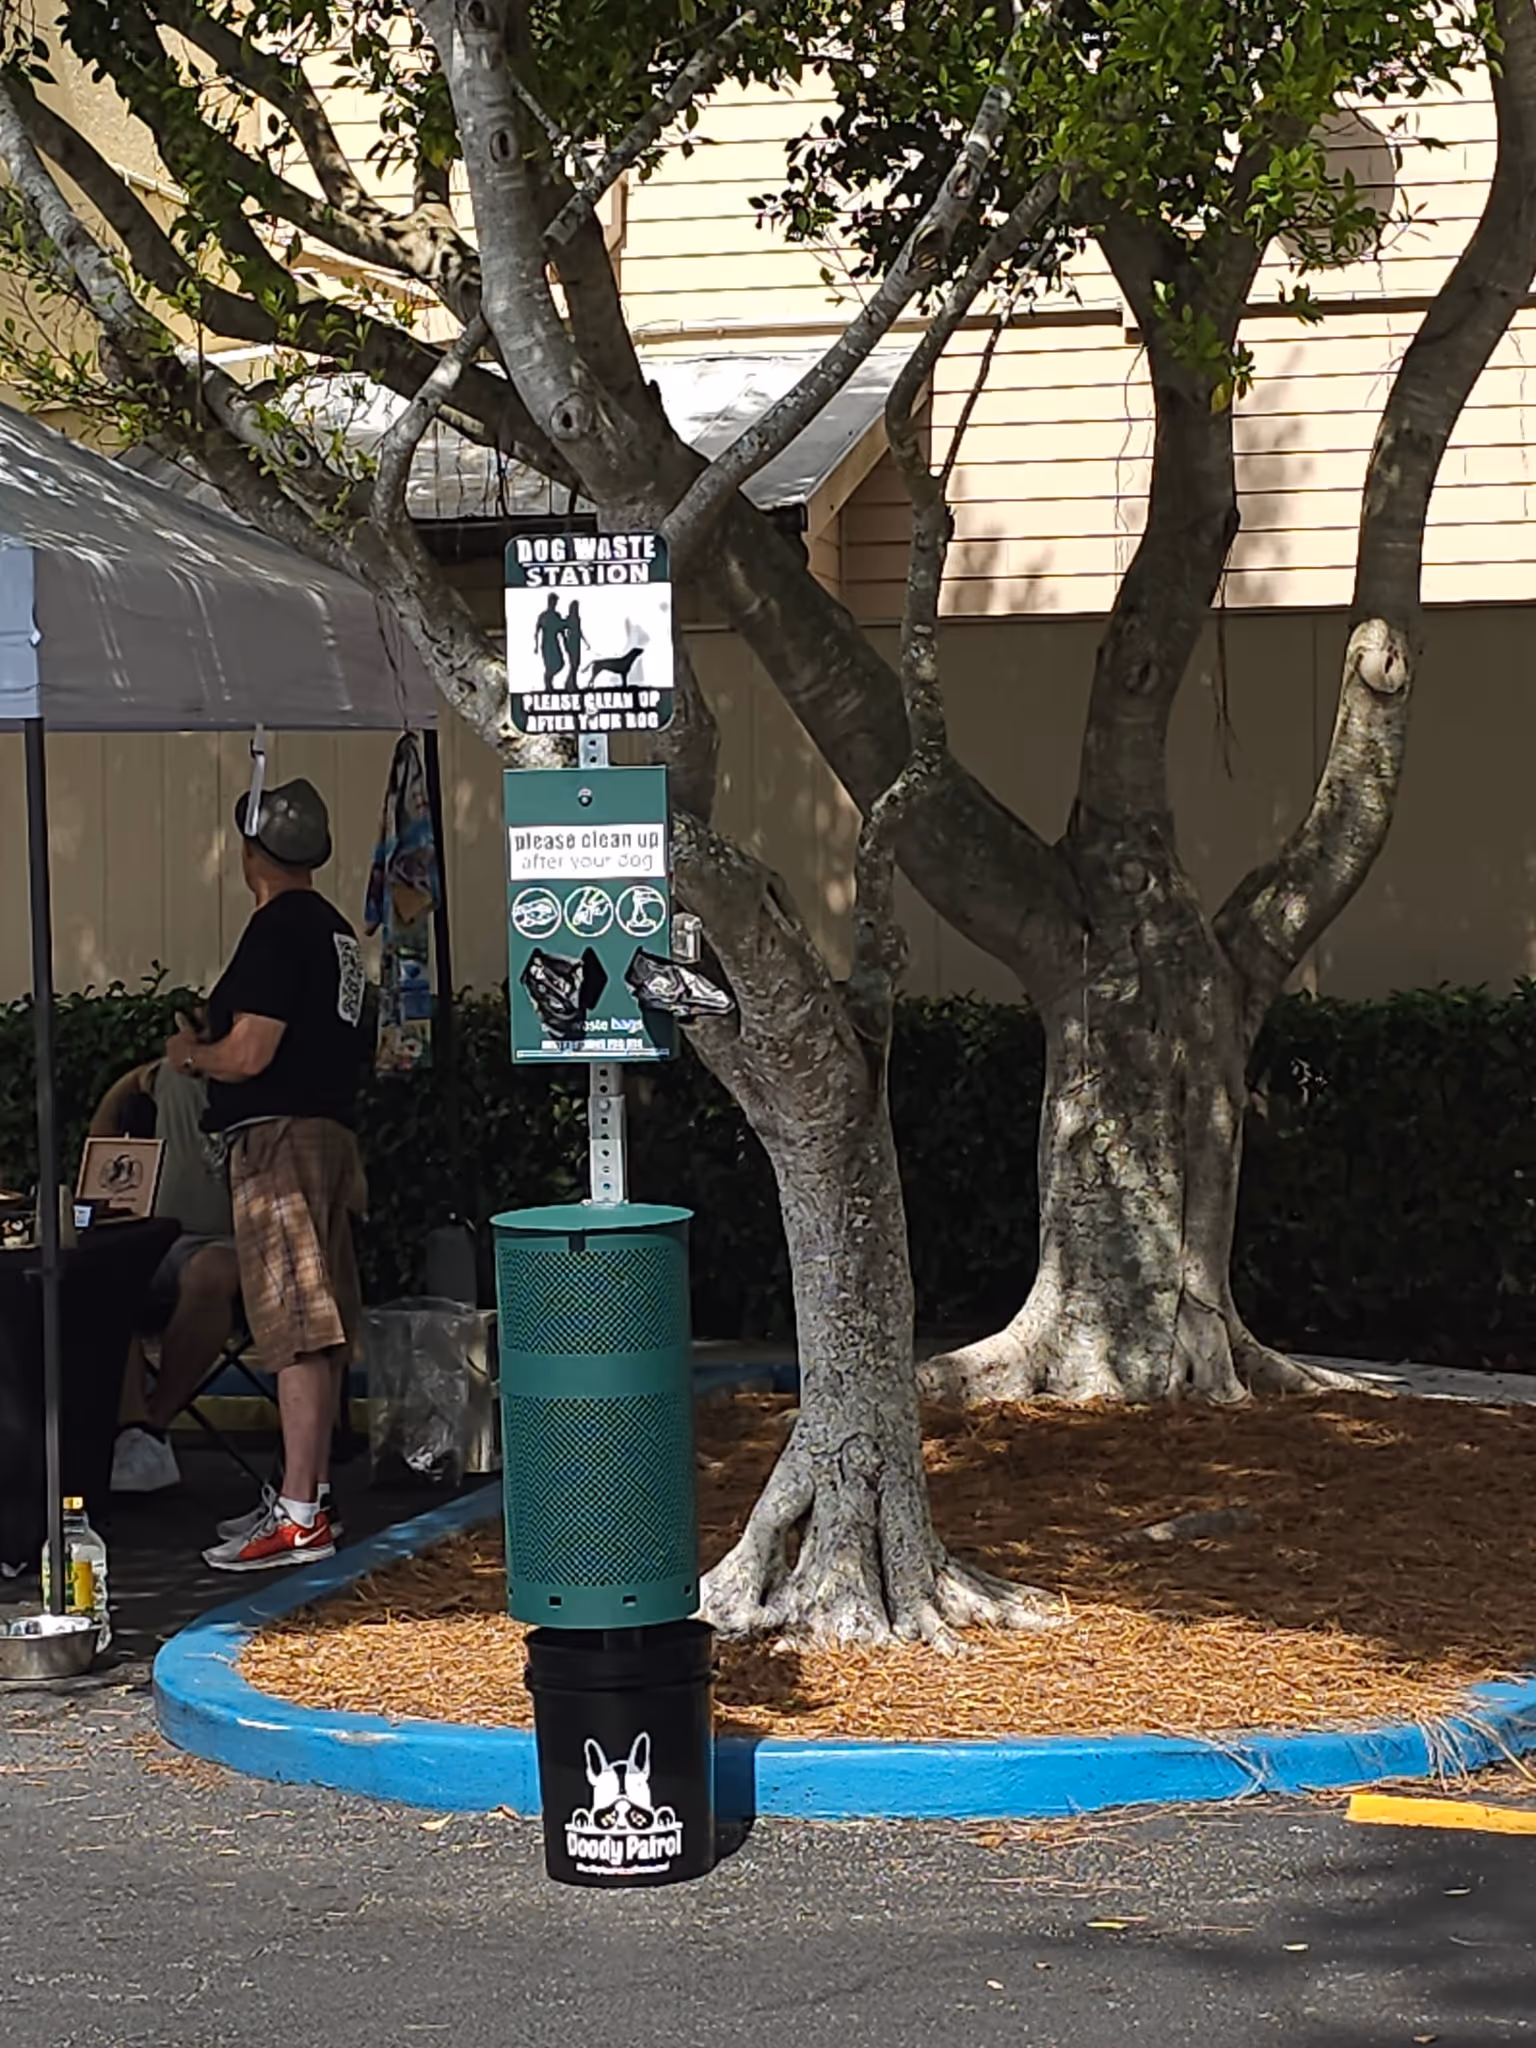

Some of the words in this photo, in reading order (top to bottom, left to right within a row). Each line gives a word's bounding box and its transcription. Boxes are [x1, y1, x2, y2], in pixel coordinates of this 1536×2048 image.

[516, 538, 567, 564] DOG
[573, 535, 657, 561] WASTE
[525, 563, 650, 588] STATION
[522, 693, 581, 712] PLEASE
[584, 691, 634, 711] CLEAN
[637, 690, 661, 709] UP
[525, 714, 576, 733] AFTER
[578, 712, 622, 731] YOUR
[625, 711, 659, 729] DOG
[514, 832, 576, 852] please
[581, 830, 632, 849] clean
[638, 831, 660, 850] up
[521, 852, 564, 870] after
[570, 855, 612, 871] your
[618, 852, 654, 872] dog
[566, 1831, 625, 1866] Doody
[626, 1828, 682, 1861] Patrol
